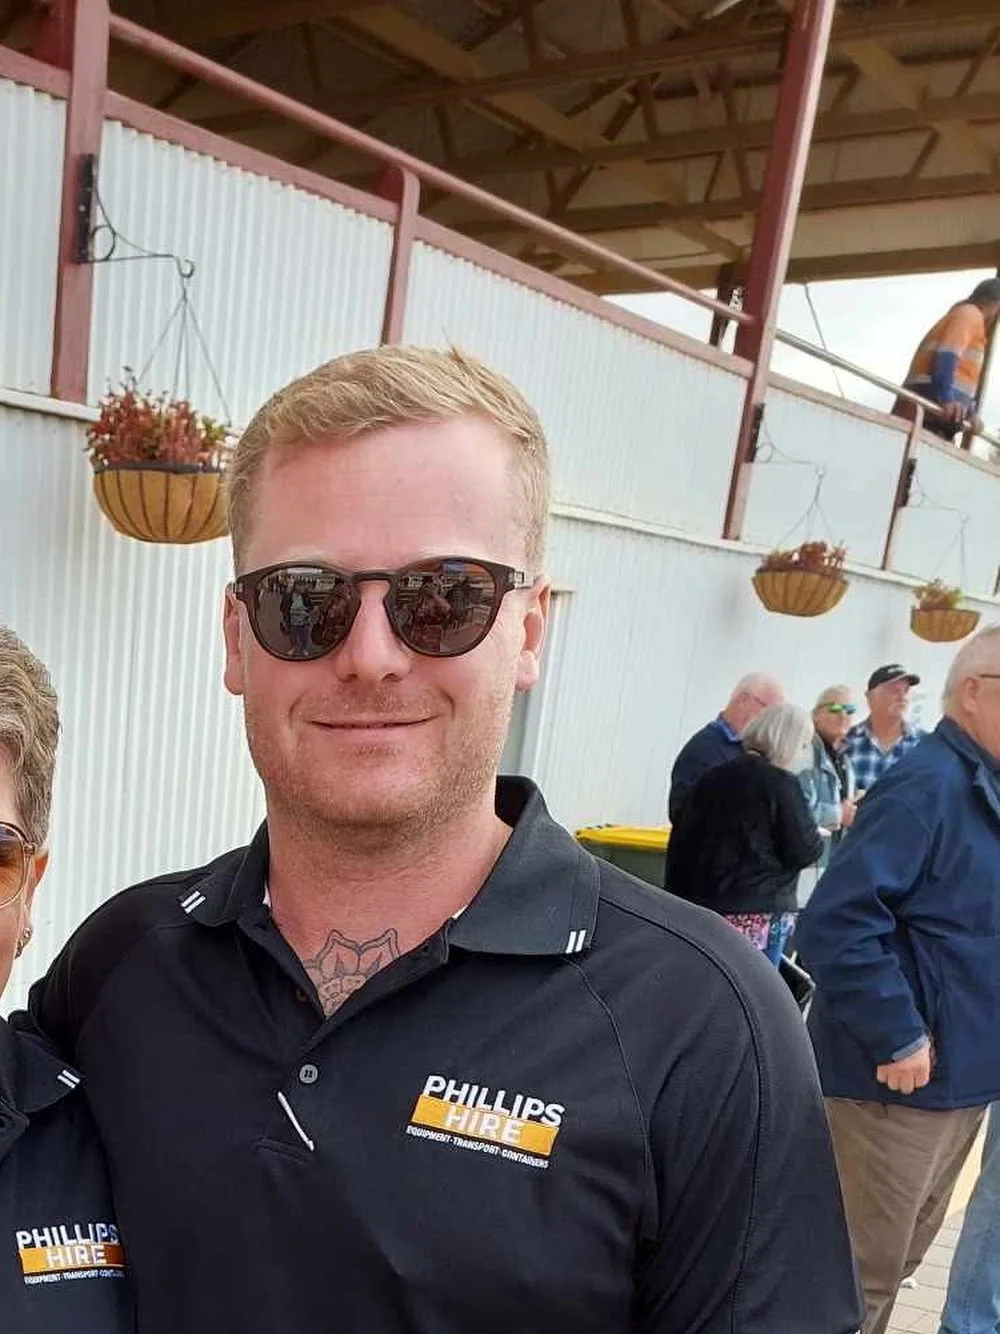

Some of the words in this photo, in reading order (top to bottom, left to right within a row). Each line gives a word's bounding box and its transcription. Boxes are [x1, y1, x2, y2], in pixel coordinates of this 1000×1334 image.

[422, 1075, 565, 1126] PHILLIPS
[444, 1105, 524, 1143] HIRE
[501, 1149, 549, 1169] CONTAINERS
[16, 1223, 119, 1249] PHILLIPS
[47, 1245, 107, 1269] HIRE
